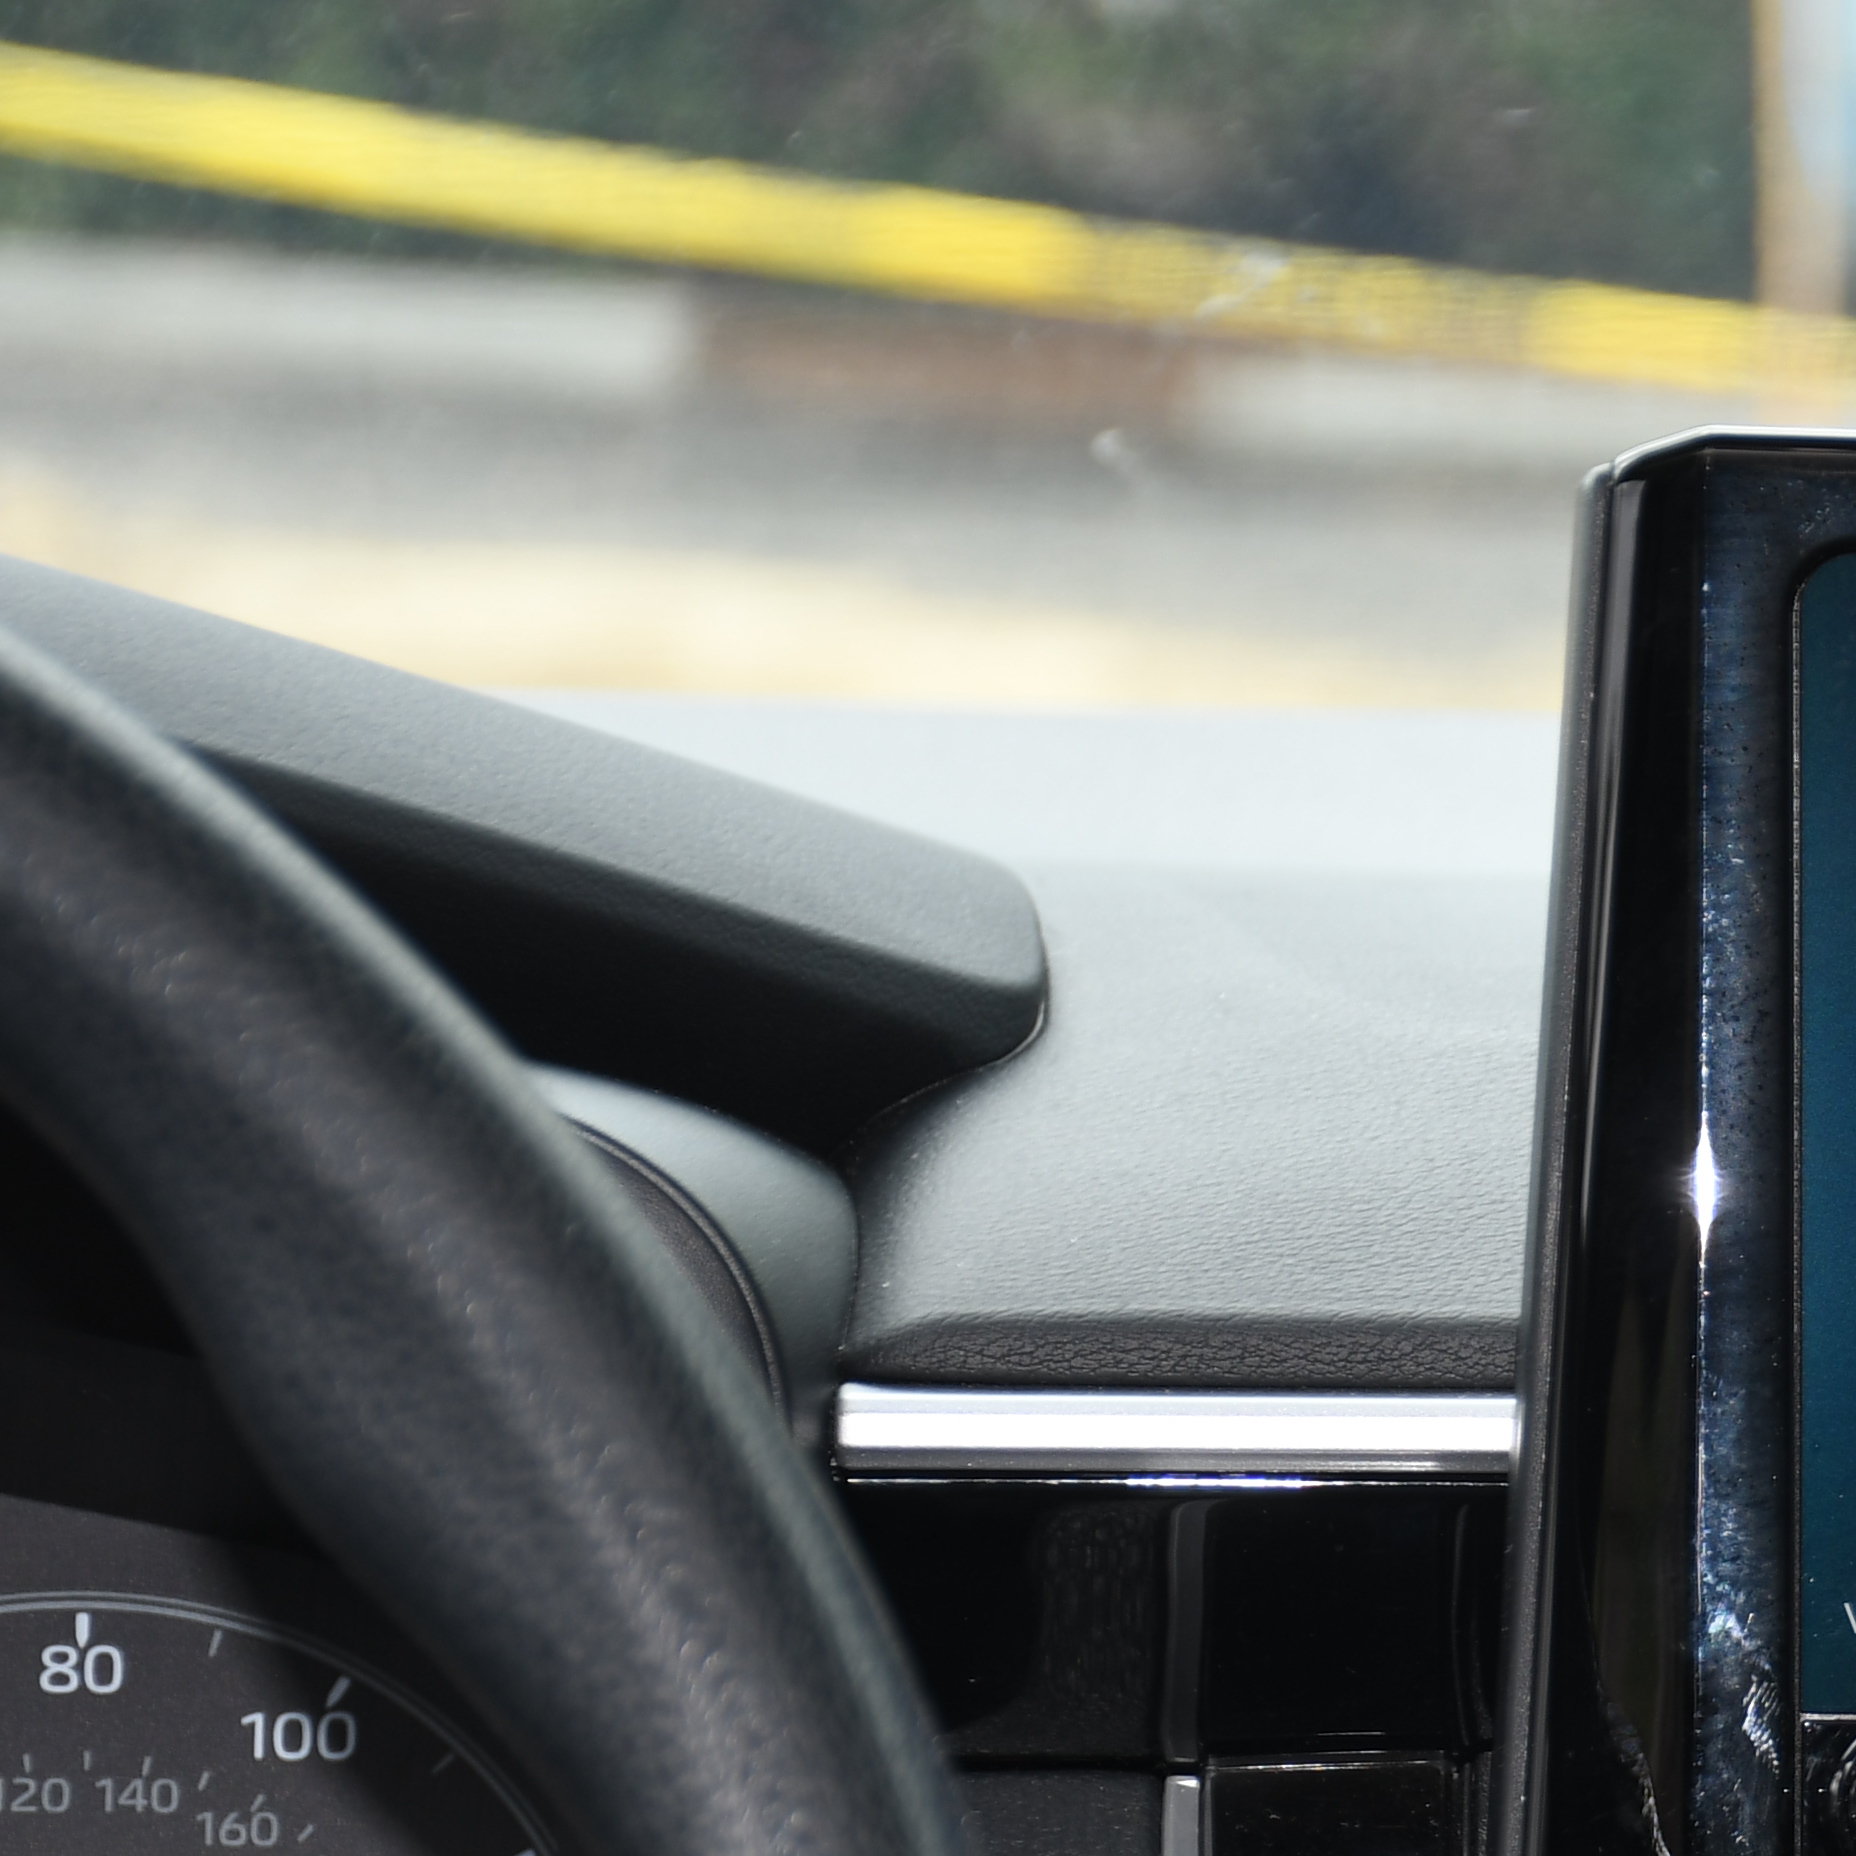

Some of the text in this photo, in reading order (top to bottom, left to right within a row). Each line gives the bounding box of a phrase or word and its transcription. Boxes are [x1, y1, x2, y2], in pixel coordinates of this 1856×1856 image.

[39, 1644, 124, 1694] 80
[240, 1711, 357, 1761] 100
[0, 1777, 70, 1813] 20
[95, 1778, 179, 1814] 140
[196, 1809, 279, 1847] 160
